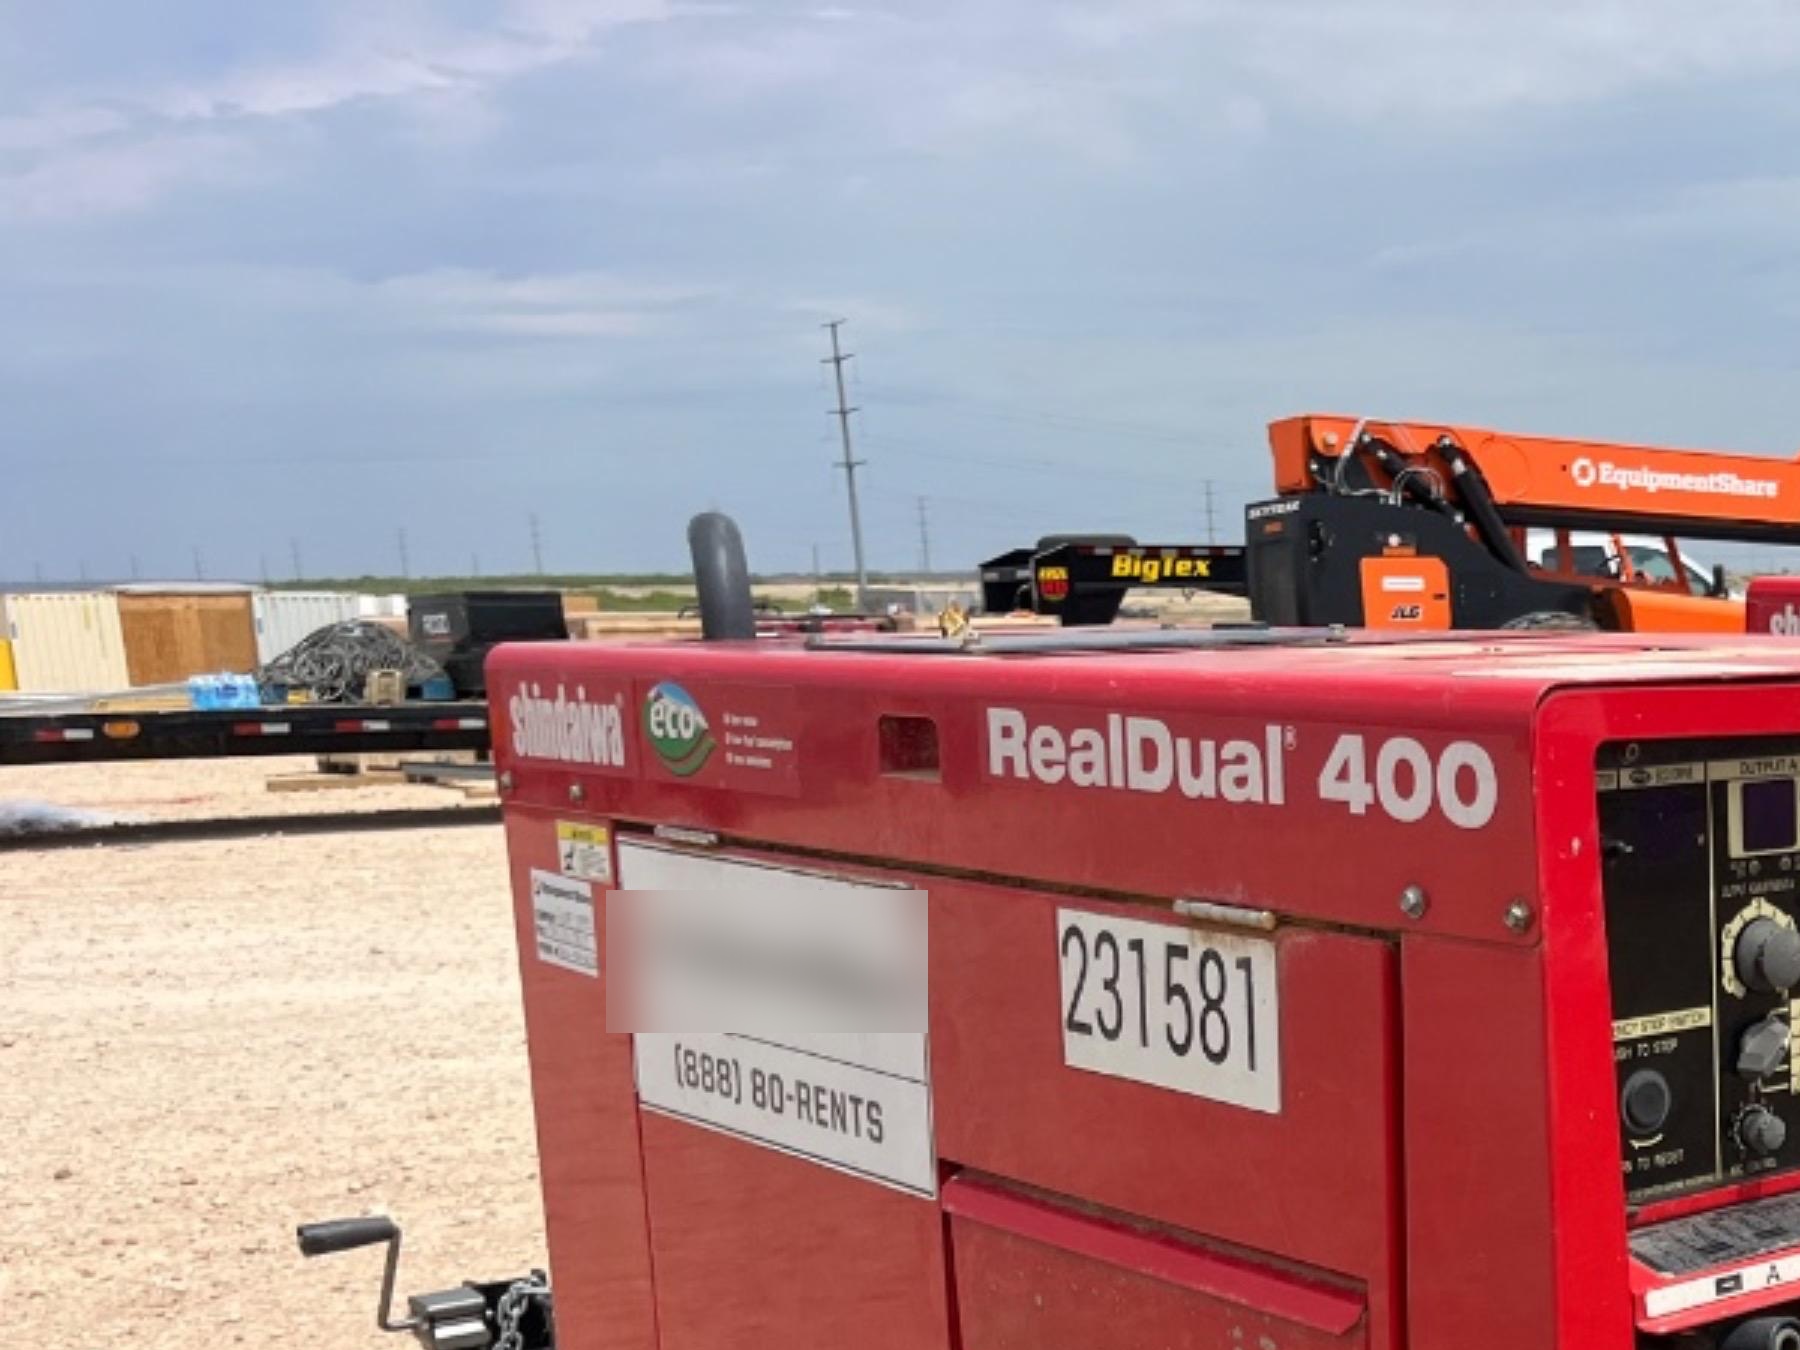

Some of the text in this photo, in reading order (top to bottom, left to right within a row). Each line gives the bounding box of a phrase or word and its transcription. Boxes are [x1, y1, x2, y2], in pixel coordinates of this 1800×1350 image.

[1598, 461, 1778, 498] EquipmentShare
[1391, 605, 1421, 619] JLG
[509, 681, 625, 768] shindaiwa
[649, 698, 696, 740] eco
[1317, 733, 1499, 830] 400
[1739, 757, 1799, 777] OUTPUT A
[1061, 924, 1257, 1072] 231581
[674, 1042, 885, 1145] (888) 80-RENTS
